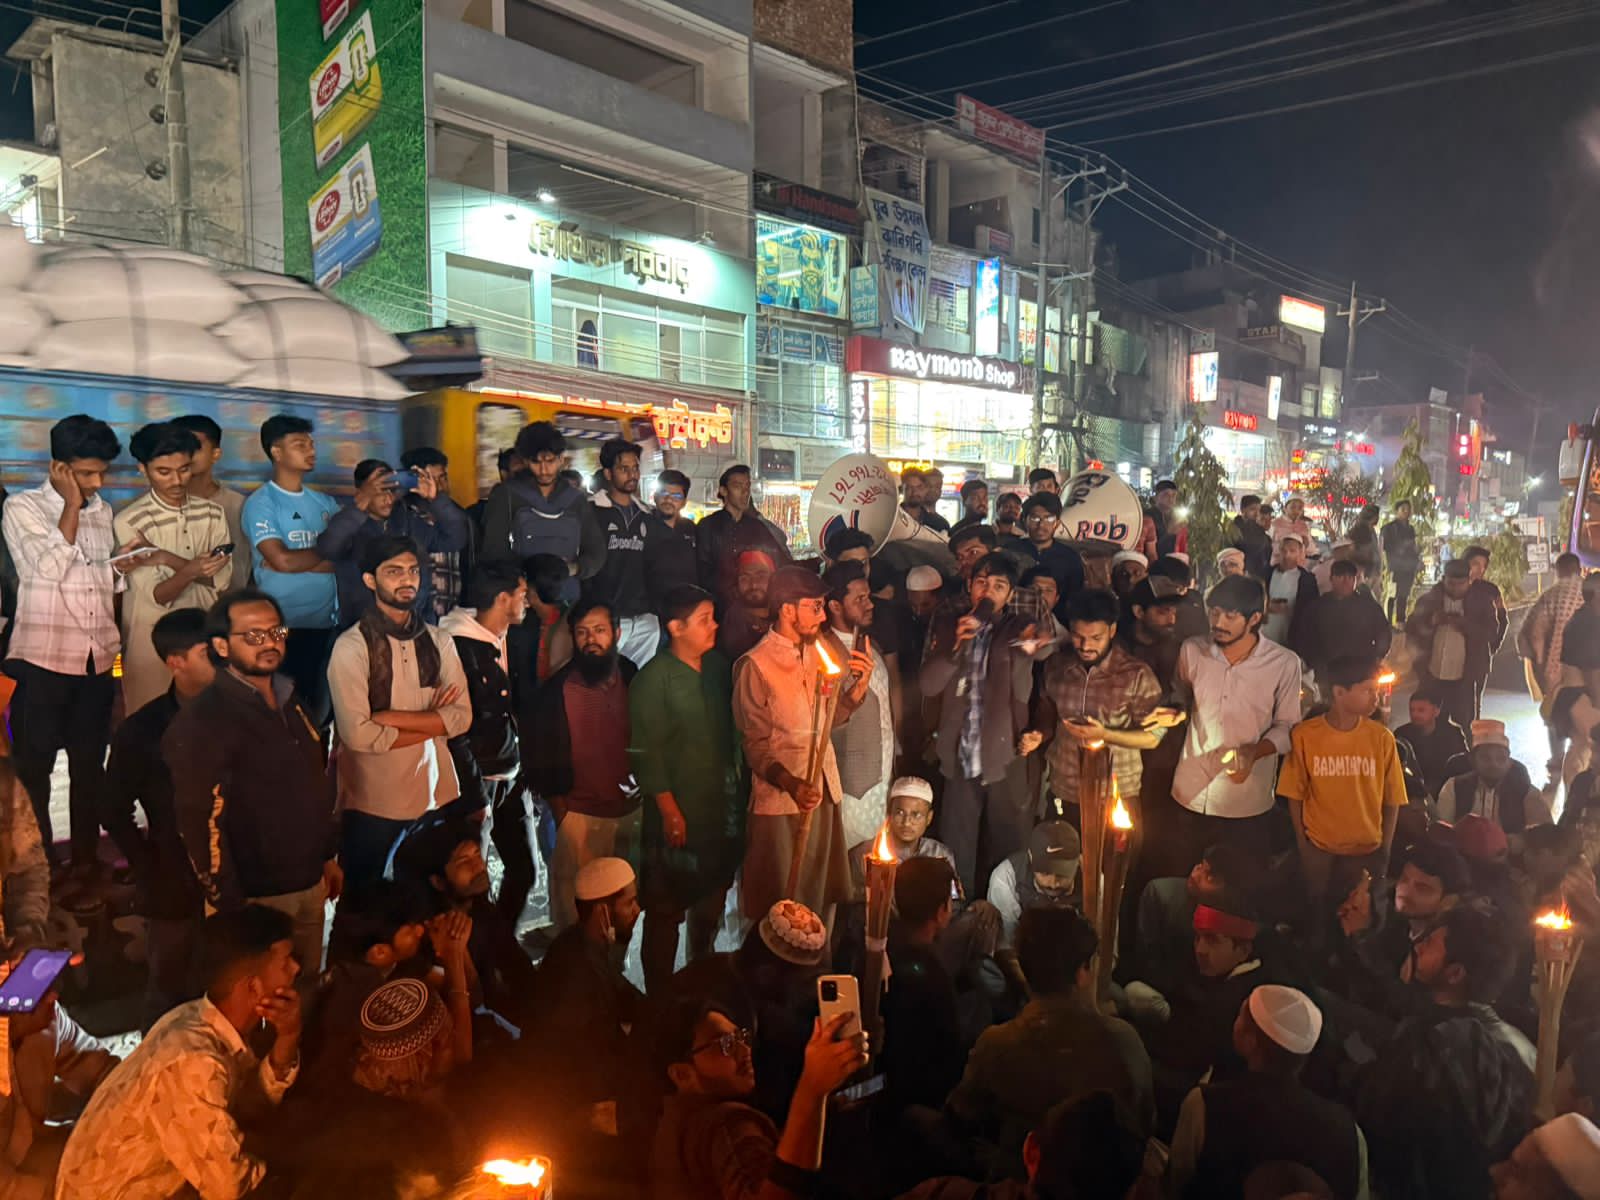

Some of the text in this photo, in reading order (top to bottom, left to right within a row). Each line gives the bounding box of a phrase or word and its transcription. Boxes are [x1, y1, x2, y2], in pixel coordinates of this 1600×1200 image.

[890, 347, 1015, 388] Raymond Shop
[1075, 514, 1129, 541] Rob
[1313, 755, 1376, 777] BADMINTON
